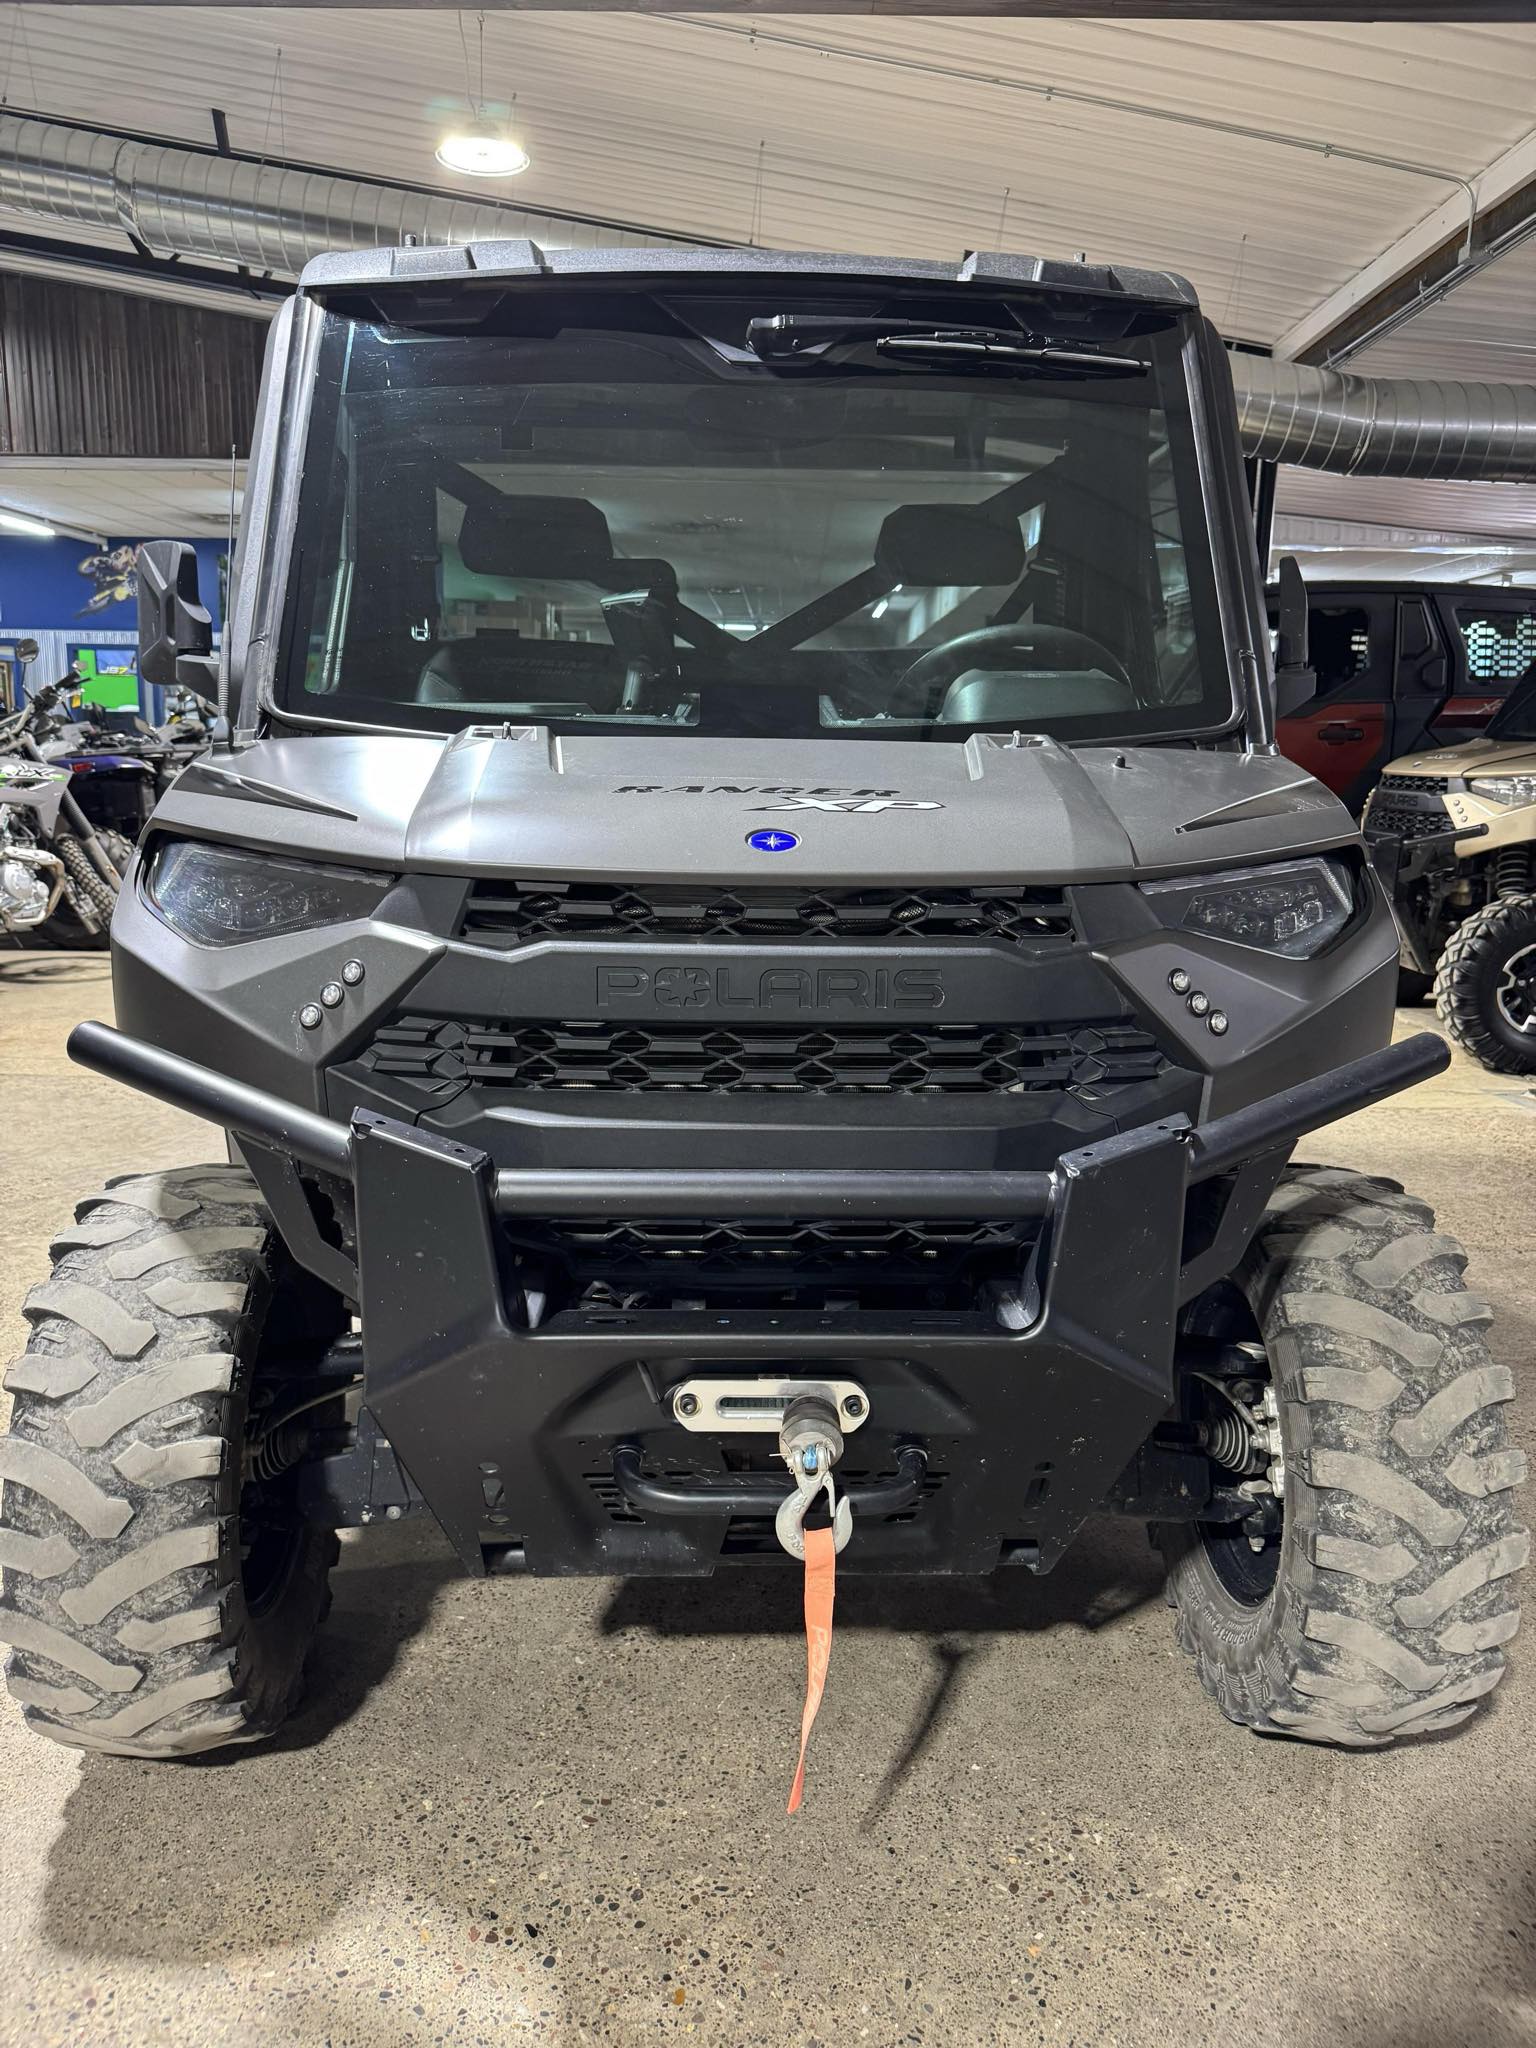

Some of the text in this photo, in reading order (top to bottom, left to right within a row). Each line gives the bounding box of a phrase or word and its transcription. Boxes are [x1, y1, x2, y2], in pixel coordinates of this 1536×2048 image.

[612, 785, 901, 797] RANGER
[742, 796, 946, 813] XP
[596, 966, 945, 1008] POLARIS
